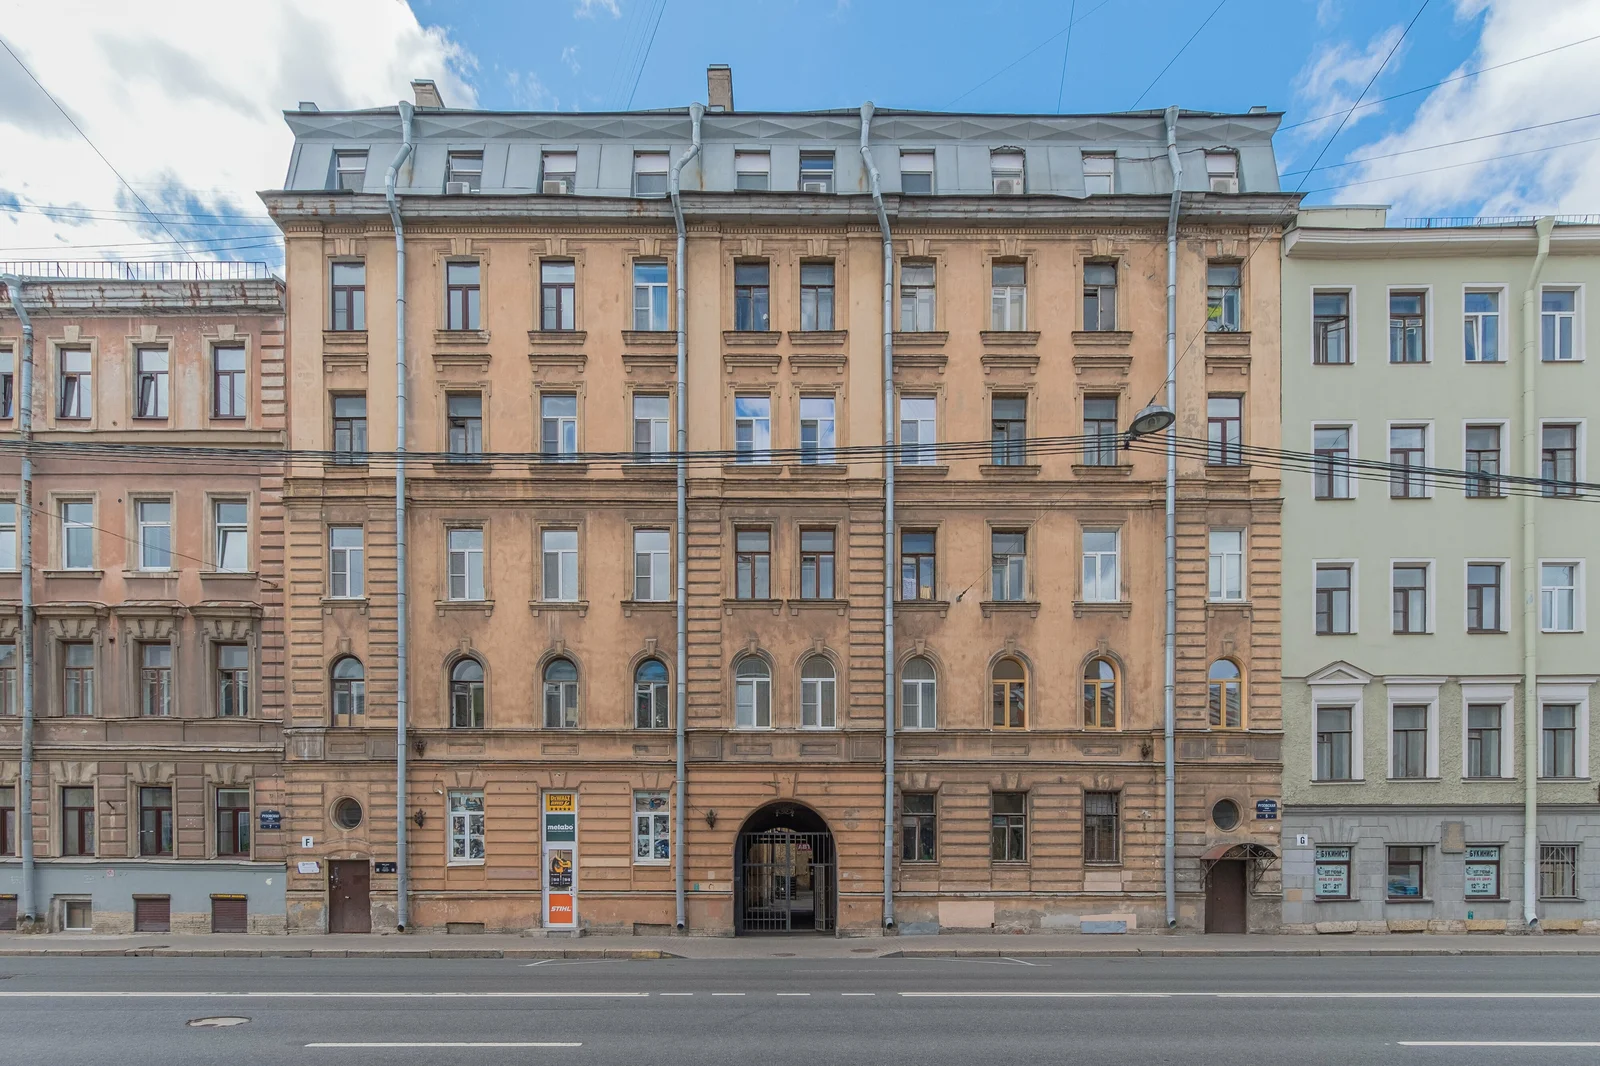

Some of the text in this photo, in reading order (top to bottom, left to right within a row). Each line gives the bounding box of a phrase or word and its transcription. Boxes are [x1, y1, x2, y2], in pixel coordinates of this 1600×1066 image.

[305, 838, 311, 847] F
[1300, 836, 1305, 845] G
[1321, 850, 1349, 858] БУКИНИСТ
